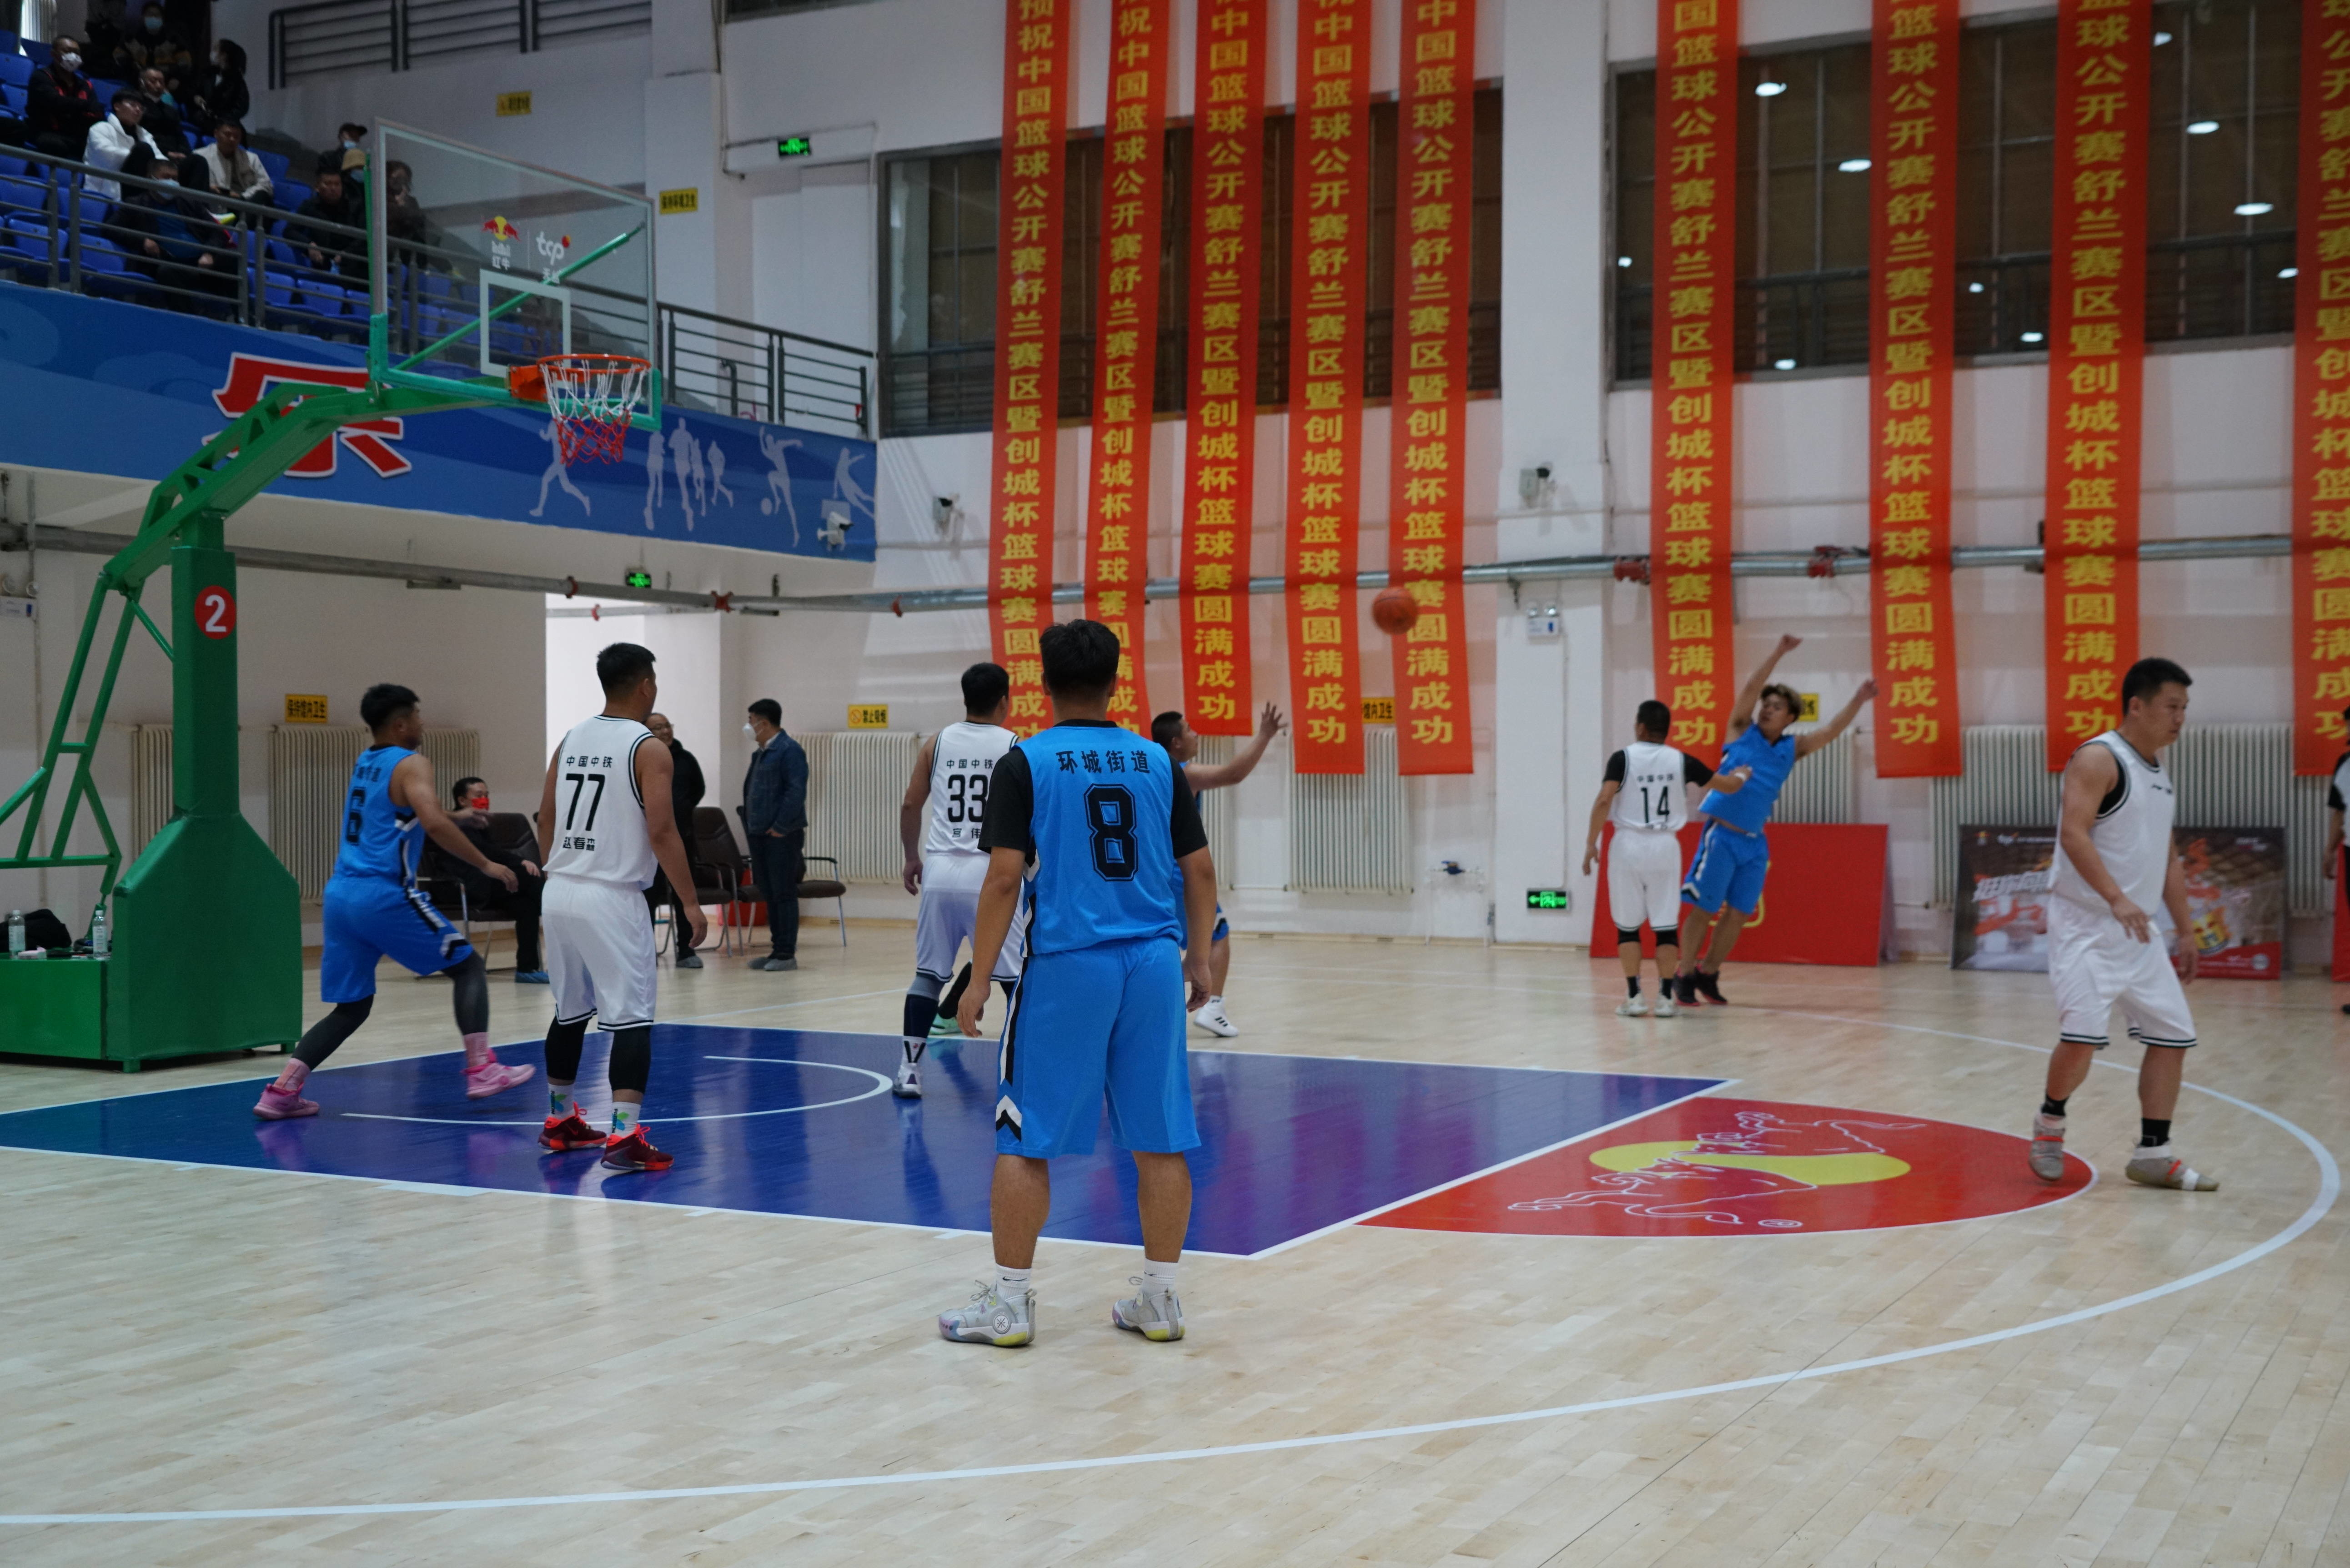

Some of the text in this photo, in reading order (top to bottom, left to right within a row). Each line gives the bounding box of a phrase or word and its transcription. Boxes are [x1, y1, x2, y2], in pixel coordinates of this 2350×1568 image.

[1193, 0, 1248, 720] 中国篮球公开赛舒兰赛区暨创城杯篮球赛圆满成功
[1299, 0, 1353, 744] 中国篮球公开赛舒兰赛区暨创城杯篮球赛圆满成功
[1882, 0, 1938, 744] 篮球公开赛舒兰赛区暨创城杯篮球赛圆满成功
[205, 594, 227, 633] 2
[566, 755, 613, 768] 中国中铁
[946, 759, 993, 769] 中国中铁
[1055, 749, 1150, 774] 环城街道
[566, 773, 605, 831] 77
[948, 774, 988, 823] 33
[1641, 785, 1670, 824] 14
[1084, 783, 1138, 881] 8
